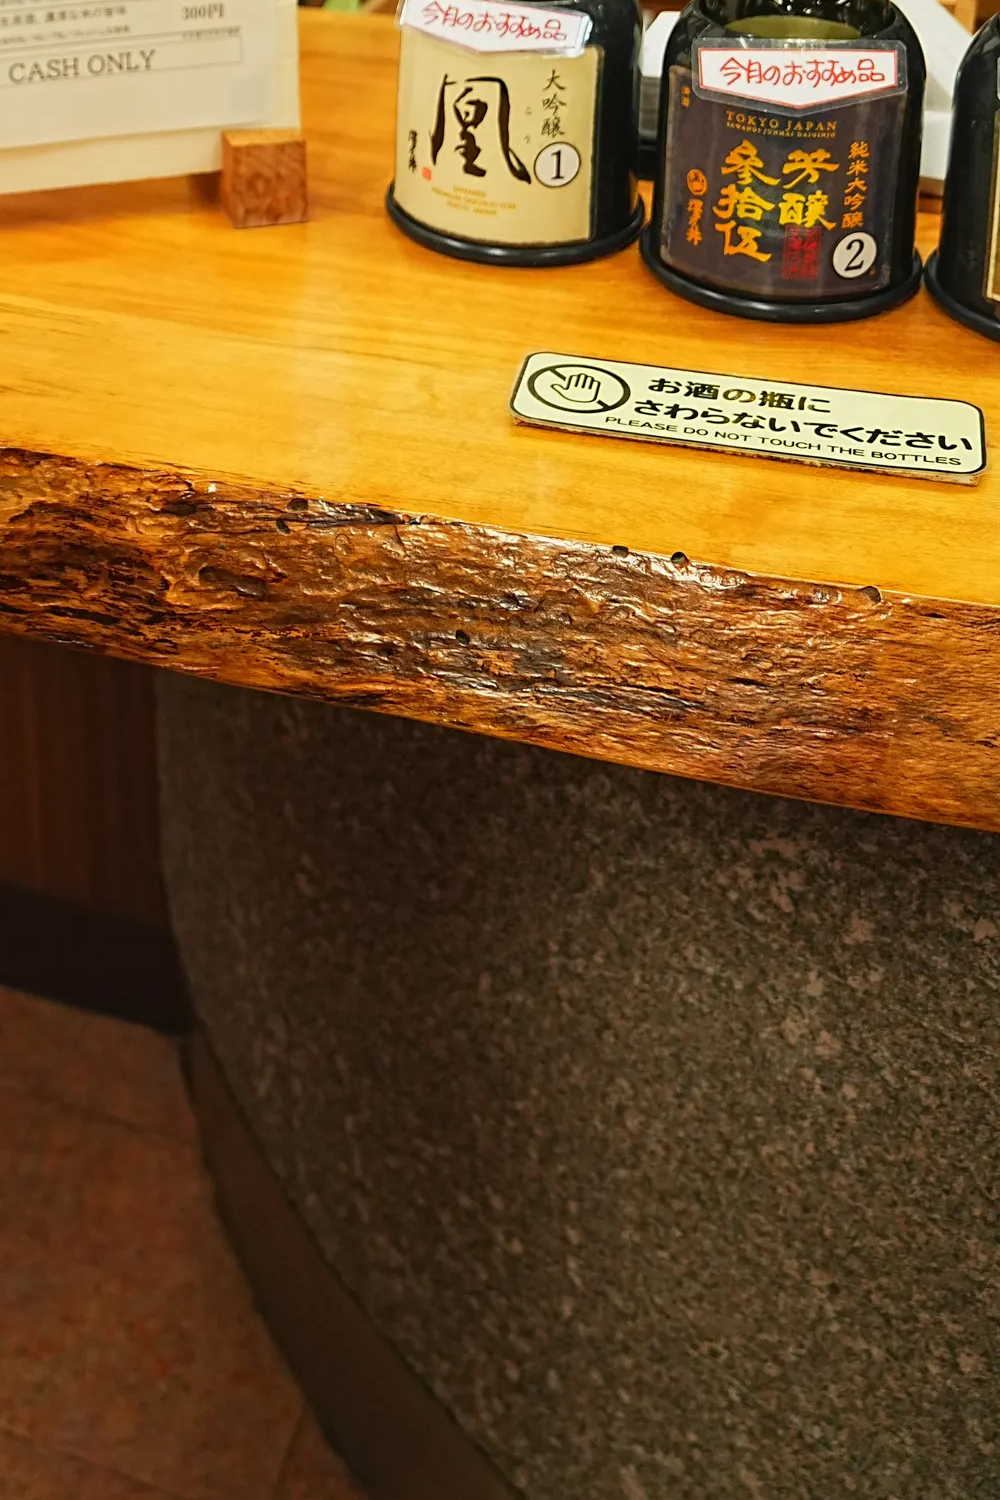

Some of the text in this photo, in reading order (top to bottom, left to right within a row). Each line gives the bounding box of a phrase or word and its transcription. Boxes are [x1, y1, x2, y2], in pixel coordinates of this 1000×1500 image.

[181, 3, 225, 20] 300円
[422, 1, 567, 41] 今月のおすすめ品
[8, 57, 79, 84] CASH
[88, 50, 155, 75] ONLY
[720, 57, 885, 88] 今月のおすすめ品
[541, 69, 567, 138] 大吟醸
[726, 110, 837, 132] TOKYO JAPAN
[778, 149, 840, 231] 芳醸
[841, 141, 869, 229] 純米大吟醸
[648, 377, 832, 414] お酒の瓶に
[605, 416, 962, 466] PLEASE DO NOT TOUCH THE BOTTLES
[633, 399, 973, 452] さわらないでください
